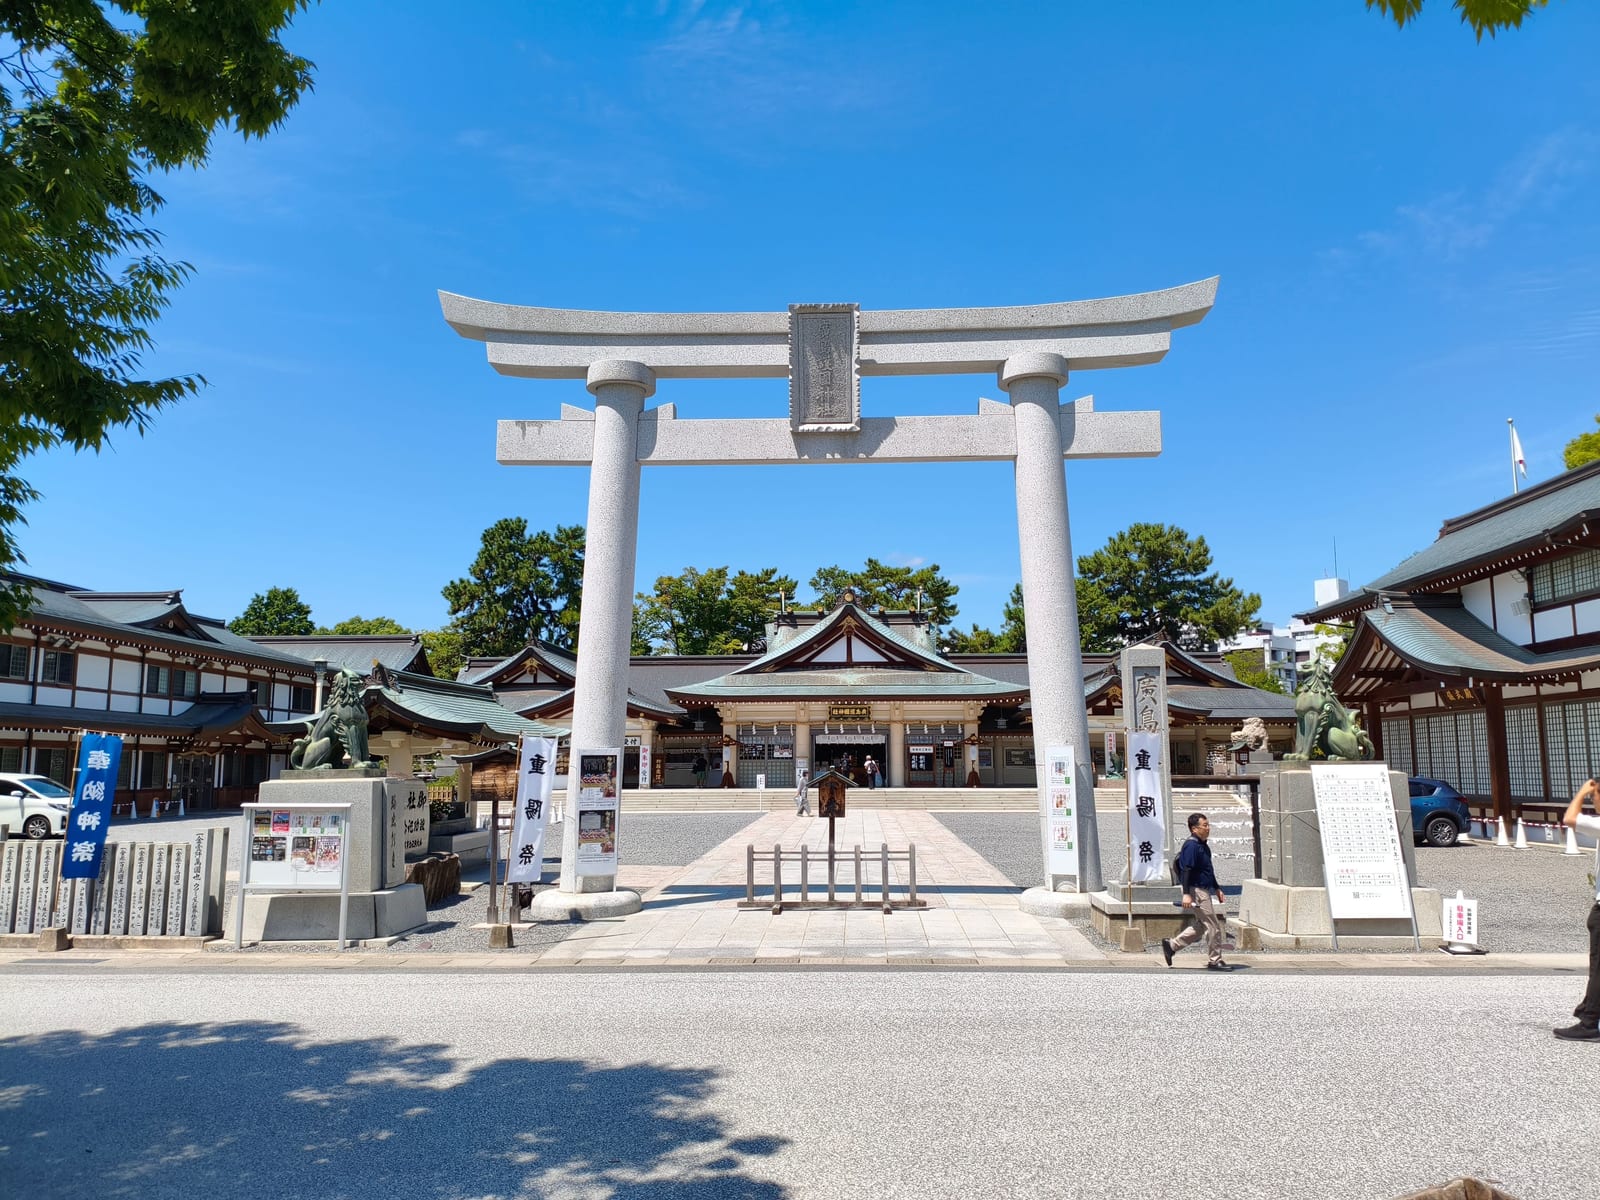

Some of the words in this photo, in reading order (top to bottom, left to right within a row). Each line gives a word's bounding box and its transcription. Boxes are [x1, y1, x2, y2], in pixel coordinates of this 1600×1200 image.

[1456, 905, 1464, 940] 駐車場入口
